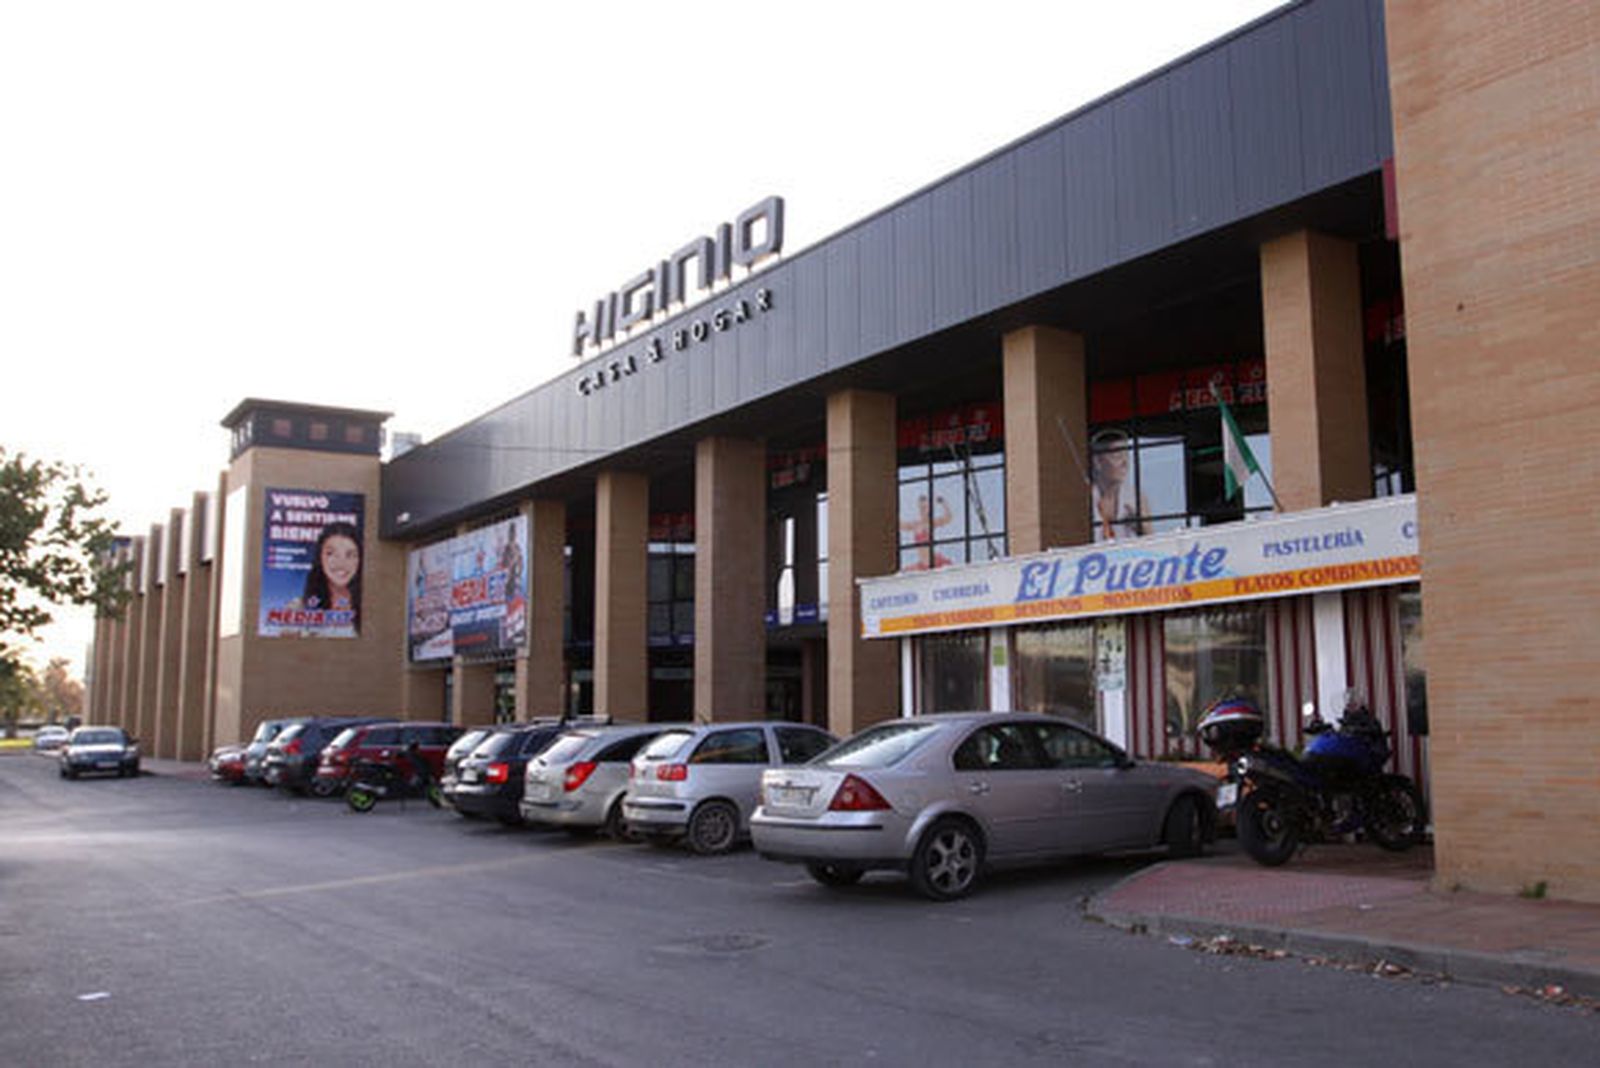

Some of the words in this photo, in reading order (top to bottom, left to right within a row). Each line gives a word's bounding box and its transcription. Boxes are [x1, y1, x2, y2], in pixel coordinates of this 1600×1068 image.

[572, 195, 786, 357] HIGINIO
[577, 355, 638, 396] CASA
[674, 287, 773, 351] HOGAR
[271, 493, 330, 508] VUELVO
[271, 510, 282, 522] A
[1014, 558, 1062, 604] El
[1067, 542, 1228, 599] Puente
[1234, 570, 1295, 594] PLATOS
[1299, 555, 1421, 587] COMBINADOS
